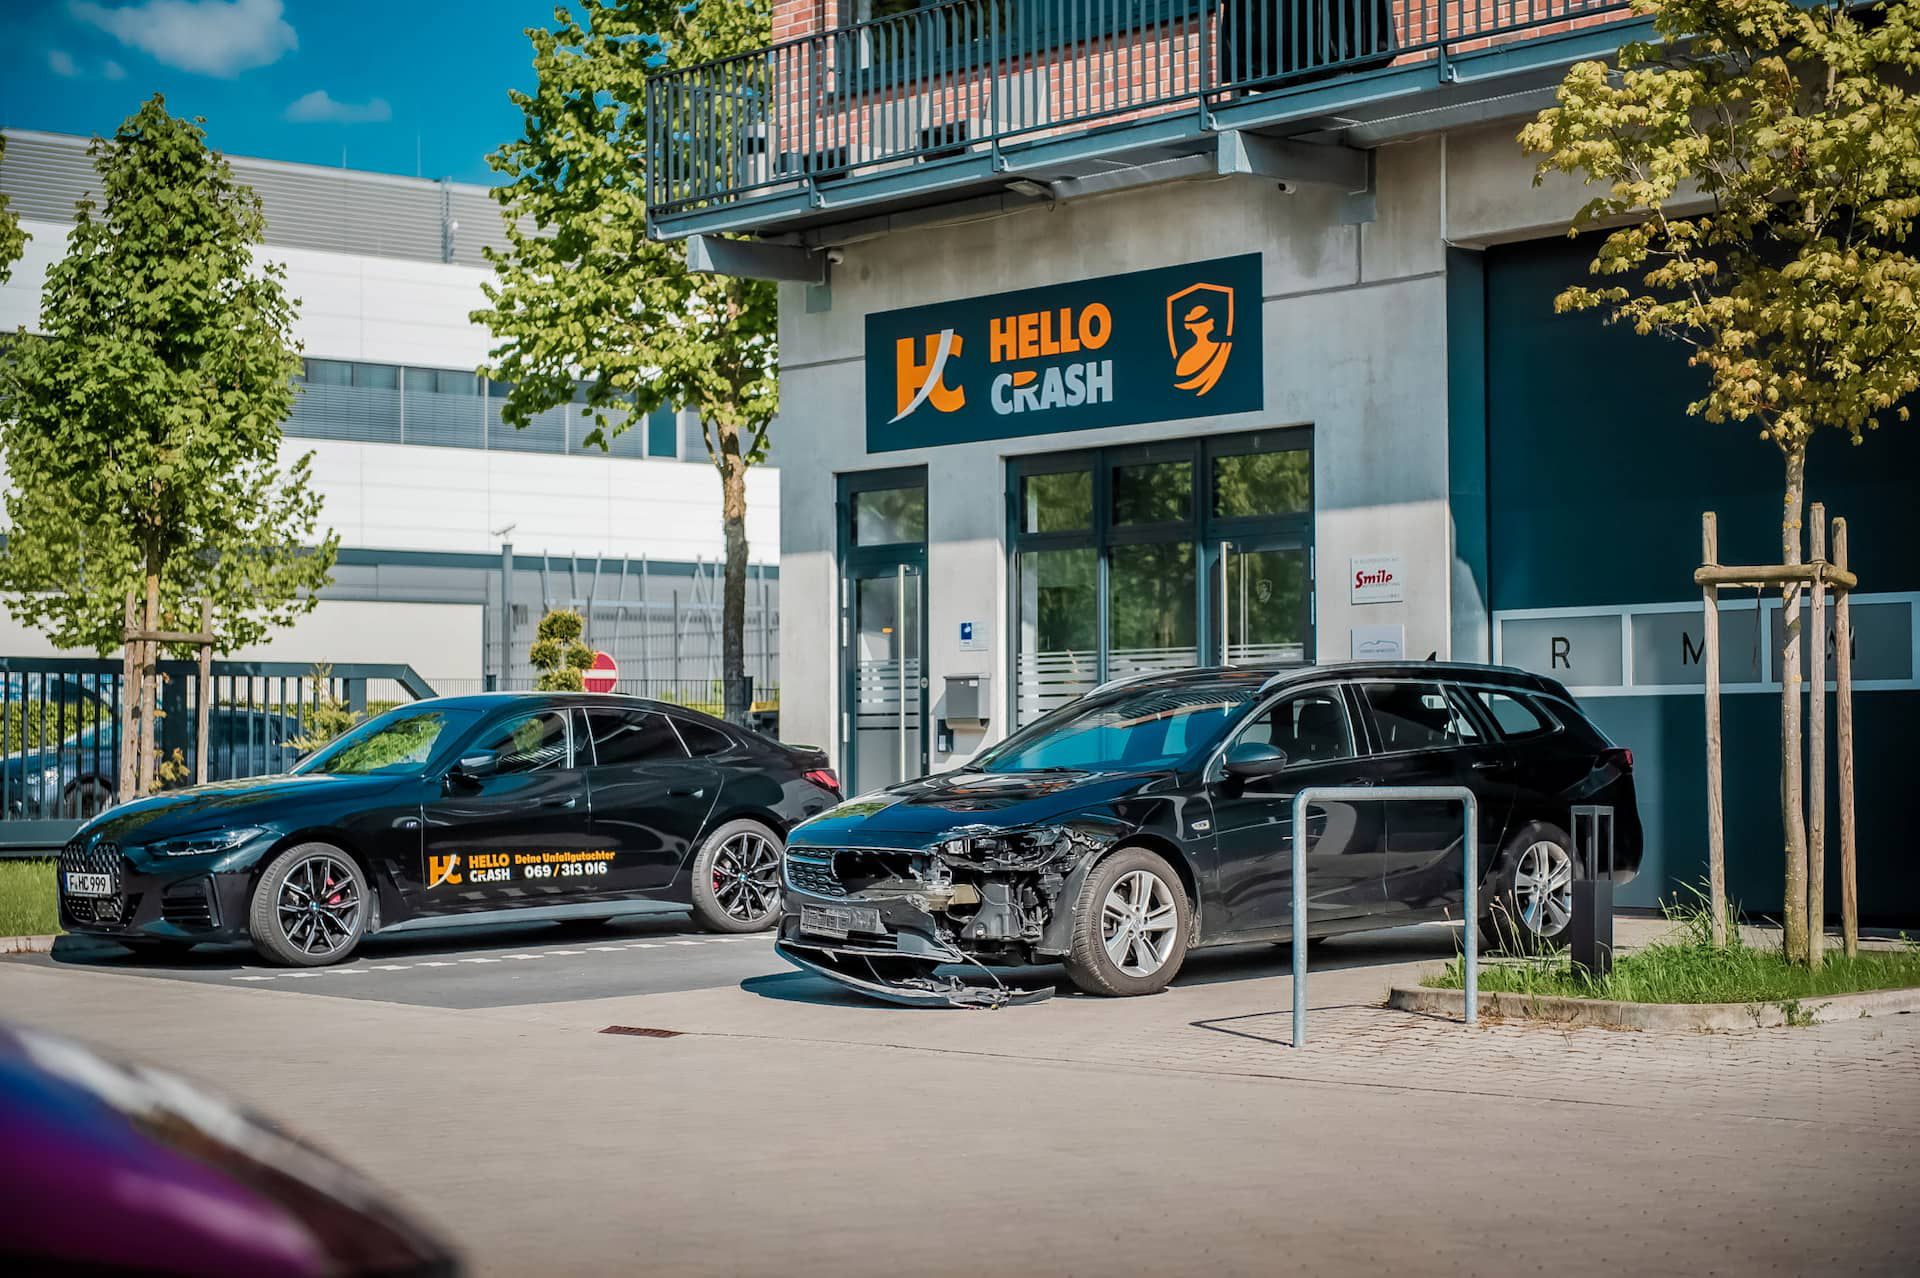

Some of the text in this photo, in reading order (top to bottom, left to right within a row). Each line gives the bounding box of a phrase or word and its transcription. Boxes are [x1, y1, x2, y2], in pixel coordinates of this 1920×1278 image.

[989, 302, 1112, 363] HELLO
[887, 329, 966, 424] HC
[991, 360, 1113, 415] CRASH
[1355, 569, 1393, 589] Smile
[1551, 637, 1570, 668] R
[468, 853, 510, 869] HELLO
[514, 850, 615, 865] Deine Unfallgutachter
[469, 867, 511, 882] CRASH
[524, 861, 608, 878] 069 / 313 016
[90, 876, 106, 891] 999
